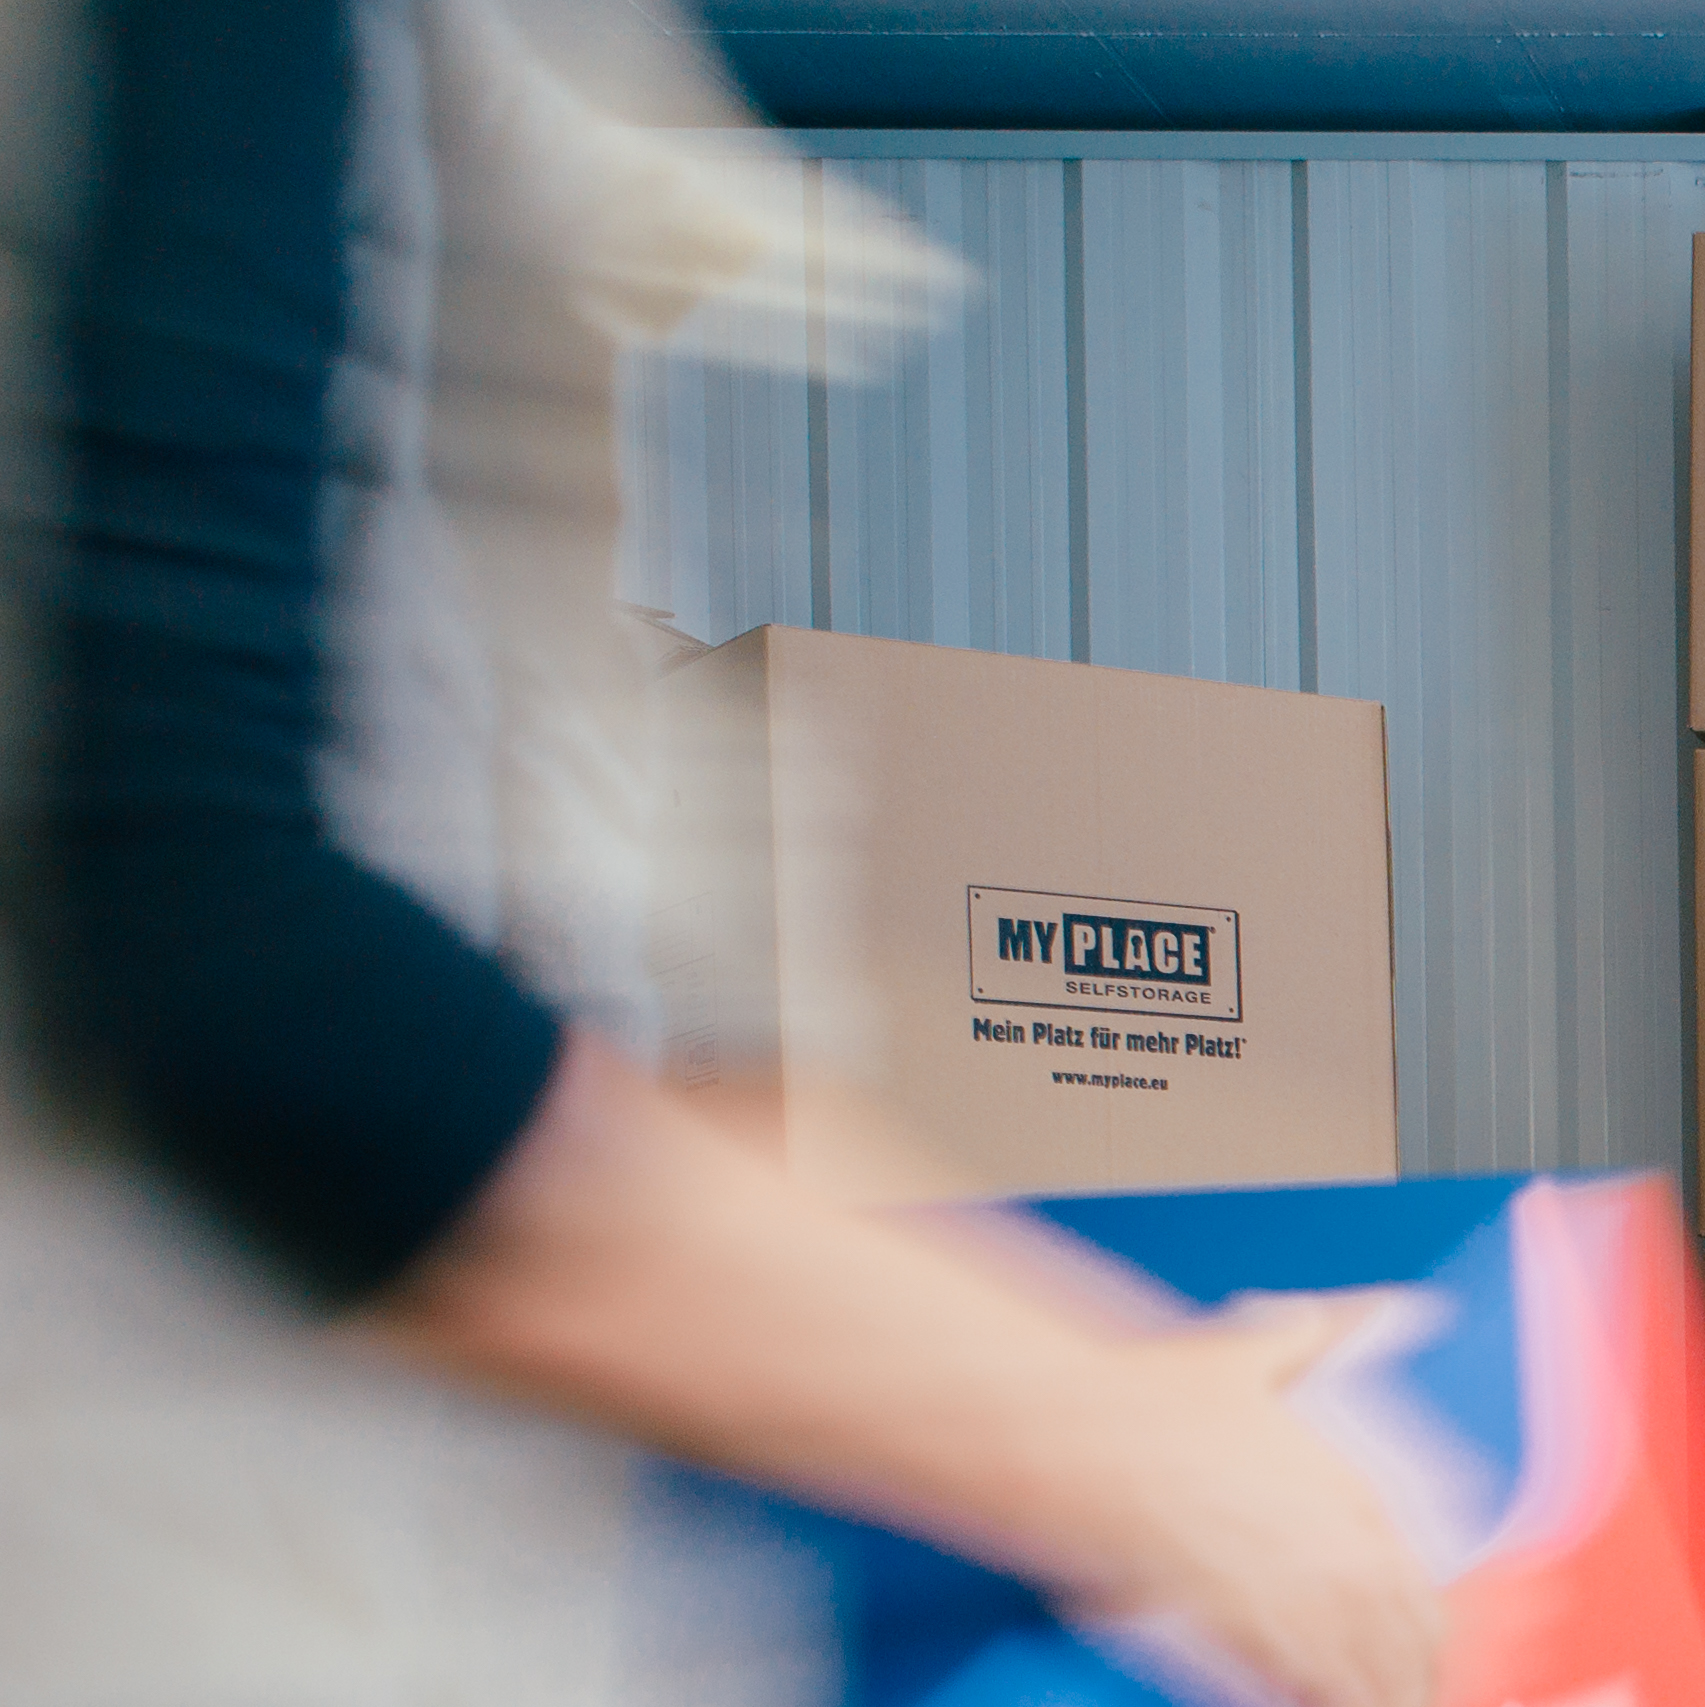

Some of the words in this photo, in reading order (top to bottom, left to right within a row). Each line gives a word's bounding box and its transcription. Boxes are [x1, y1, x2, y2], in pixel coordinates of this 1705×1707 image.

[998, 917, 1058, 964] MY
[1071, 922, 1203, 977] PLACE
[1066, 980, 1212, 1005] SELFSTORAGE
[972, 1017, 1026, 1043] Mein
[1032, 1021, 1084, 1048] Platz
[1091, 1026, 1120, 1051] für
[1126, 1030, 1179, 1055] mehr
[1186, 1033, 1241, 1060] Platz!
[1052, 1071, 1168, 1091] www.myplace.eu
